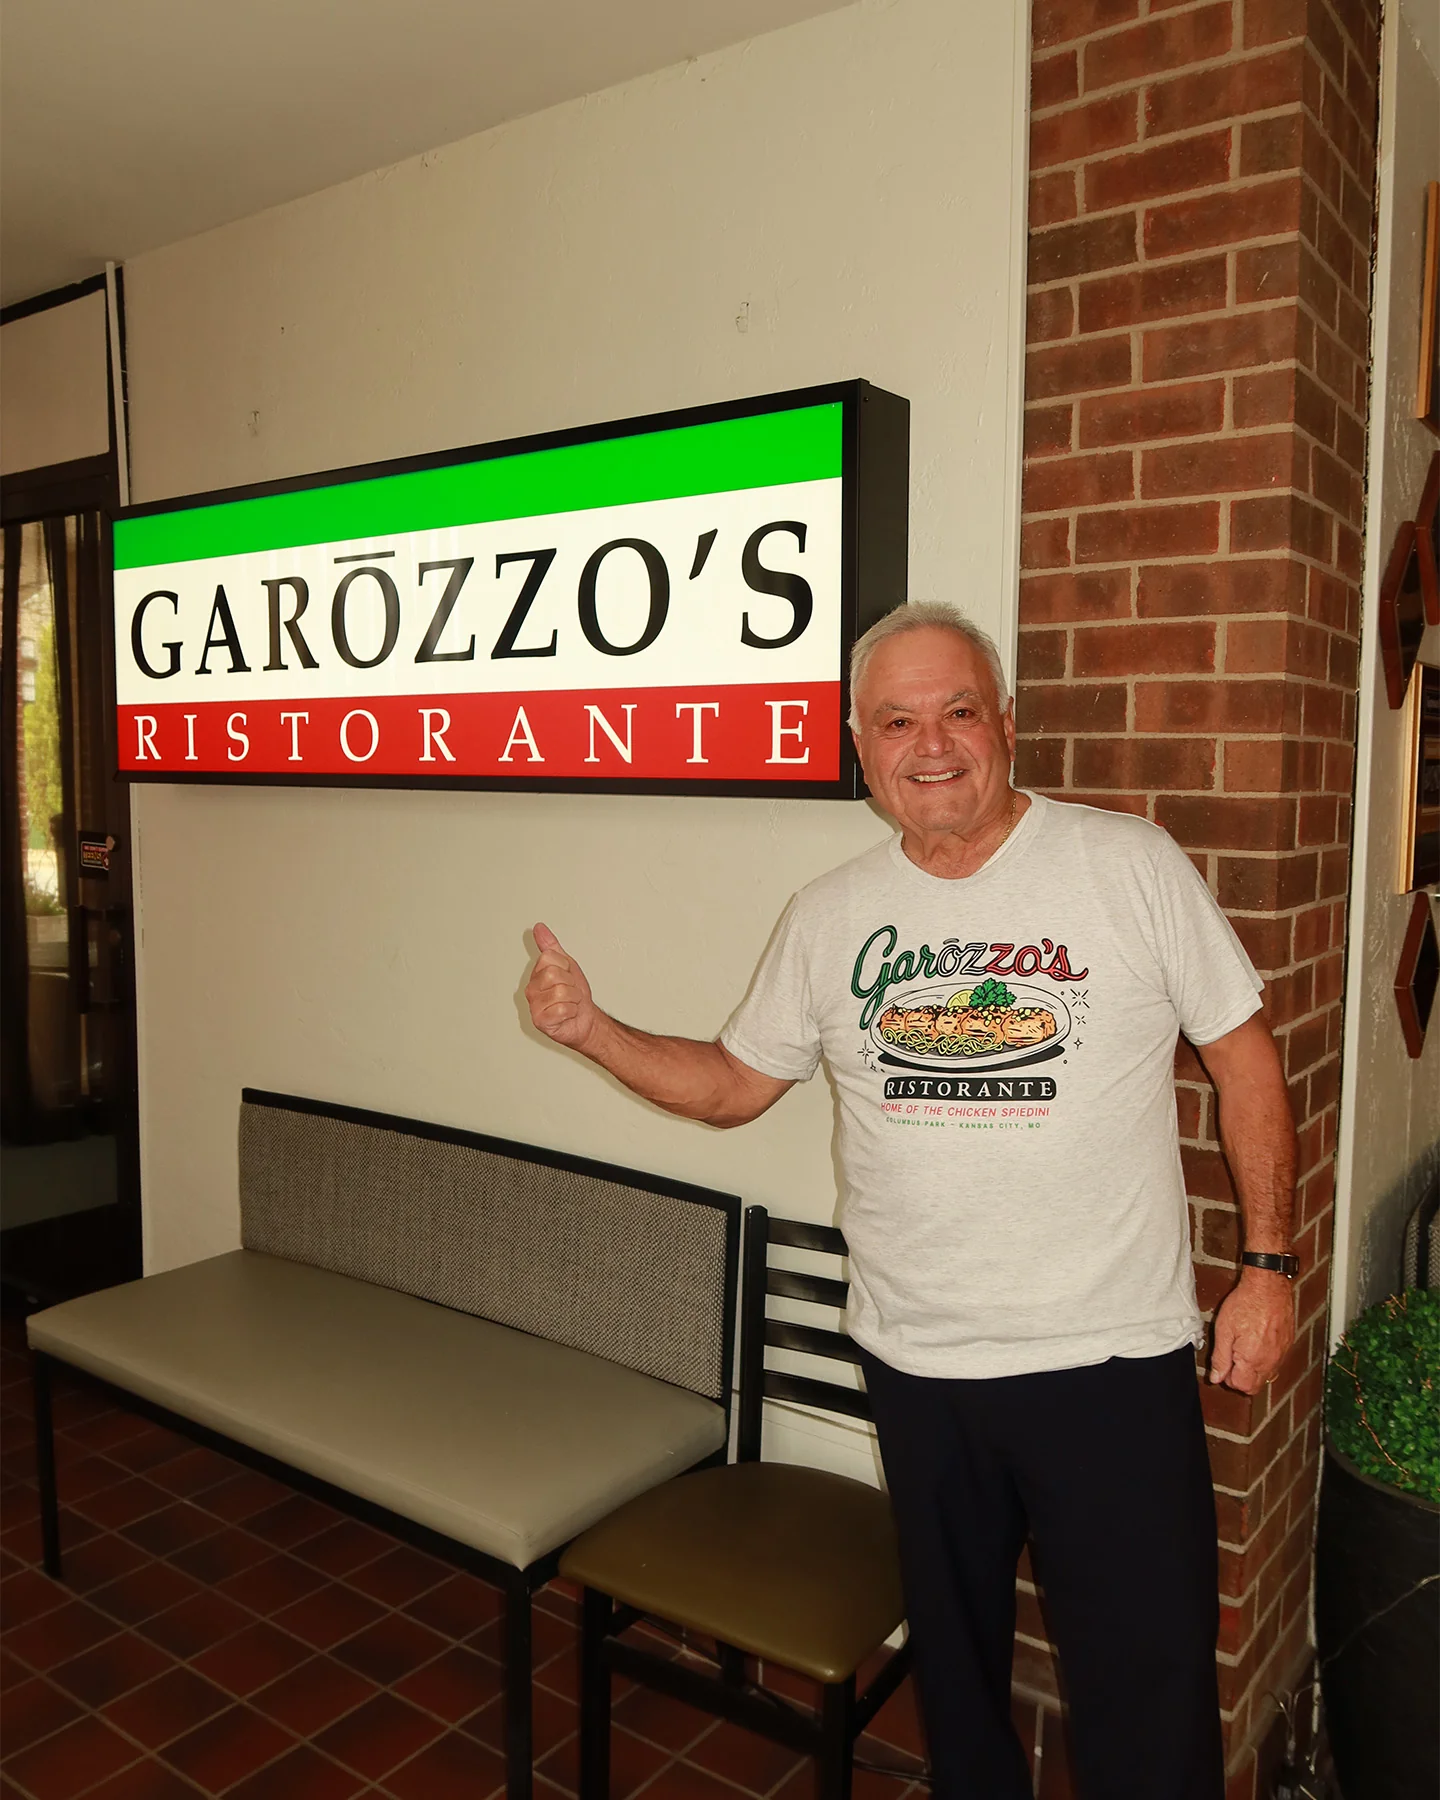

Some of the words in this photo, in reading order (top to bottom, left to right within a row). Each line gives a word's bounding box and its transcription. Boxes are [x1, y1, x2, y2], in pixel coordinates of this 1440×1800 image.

[130, 520, 814, 679] GARŌZZO'S
[134, 700, 812, 765] RISTORANTE
[850, 924, 1089, 1030] Garōzzo's
[880, 1102, 903, 1113] HOME
[906, 1104, 919, 1114] OF
[924, 1105, 943, 1116] THE
[947, 1106, 997, 1117] CHICKEN
[1001, 1107, 1050, 1117] SPIEDINI
[886, 1080, 1053, 1098] RISTORANTE
[886, 1116, 921, 1126] COLUMBUS
[999, 1122, 1024, 1130] CITY,
